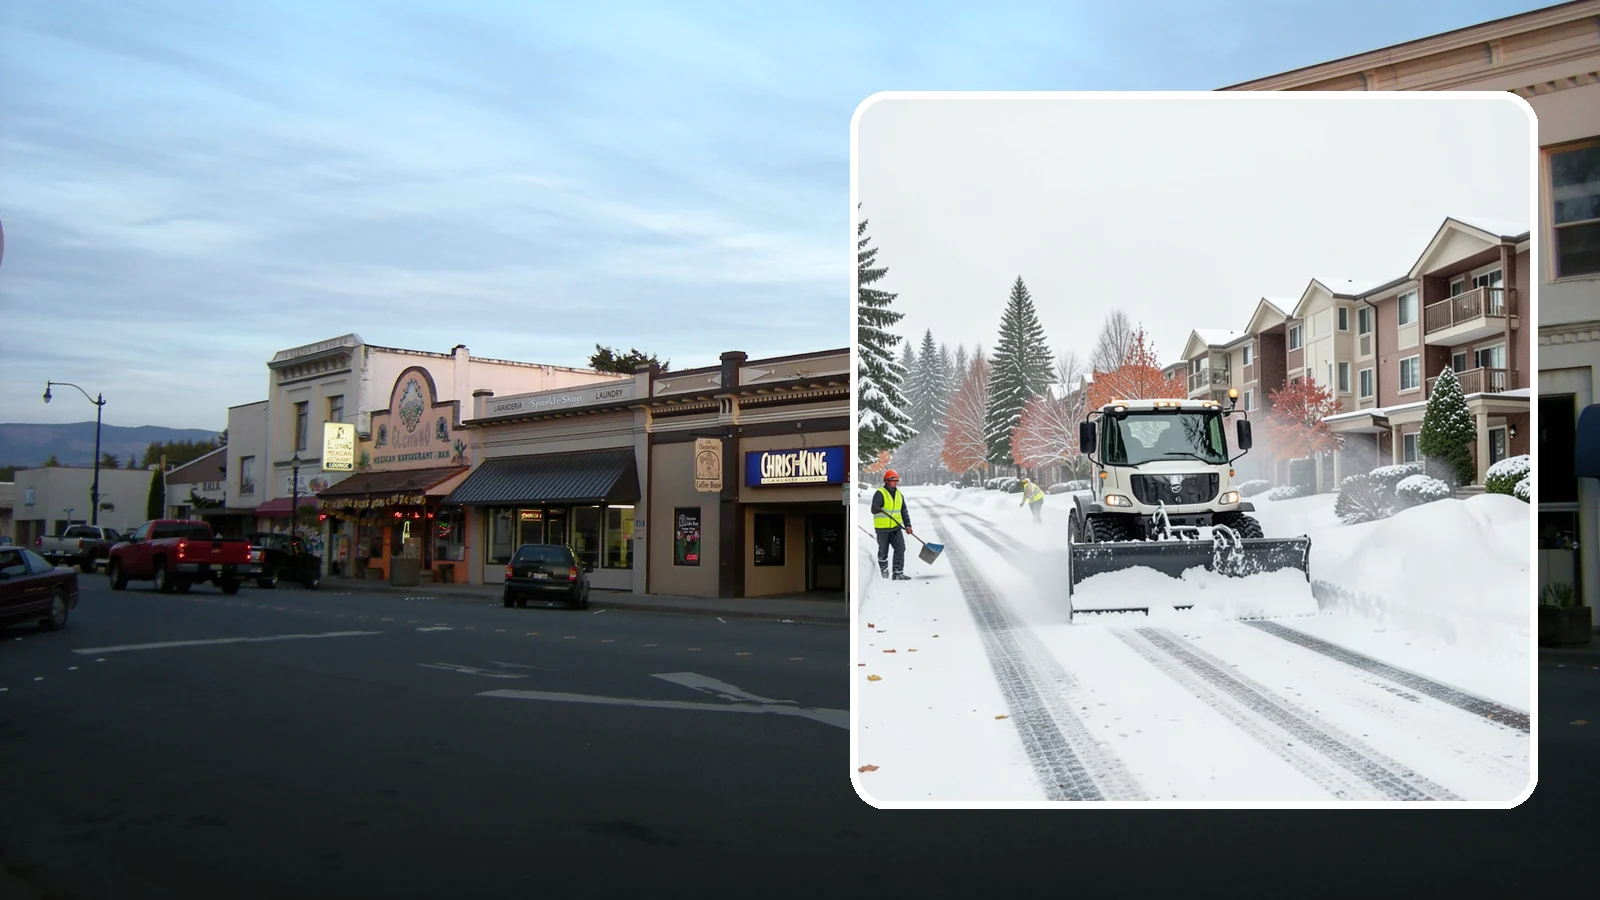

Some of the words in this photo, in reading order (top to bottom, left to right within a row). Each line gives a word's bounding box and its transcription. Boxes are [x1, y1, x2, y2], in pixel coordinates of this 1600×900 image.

[561, 394, 582, 404] Shop
[595, 388, 623, 400] LAUNDRY
[493, 402, 523, 413] LAVANDERIA
[397, 451, 433, 462] RESTAURANT
[437, 450, 450, 459] BAR
[799, 450, 827, 476] KING
